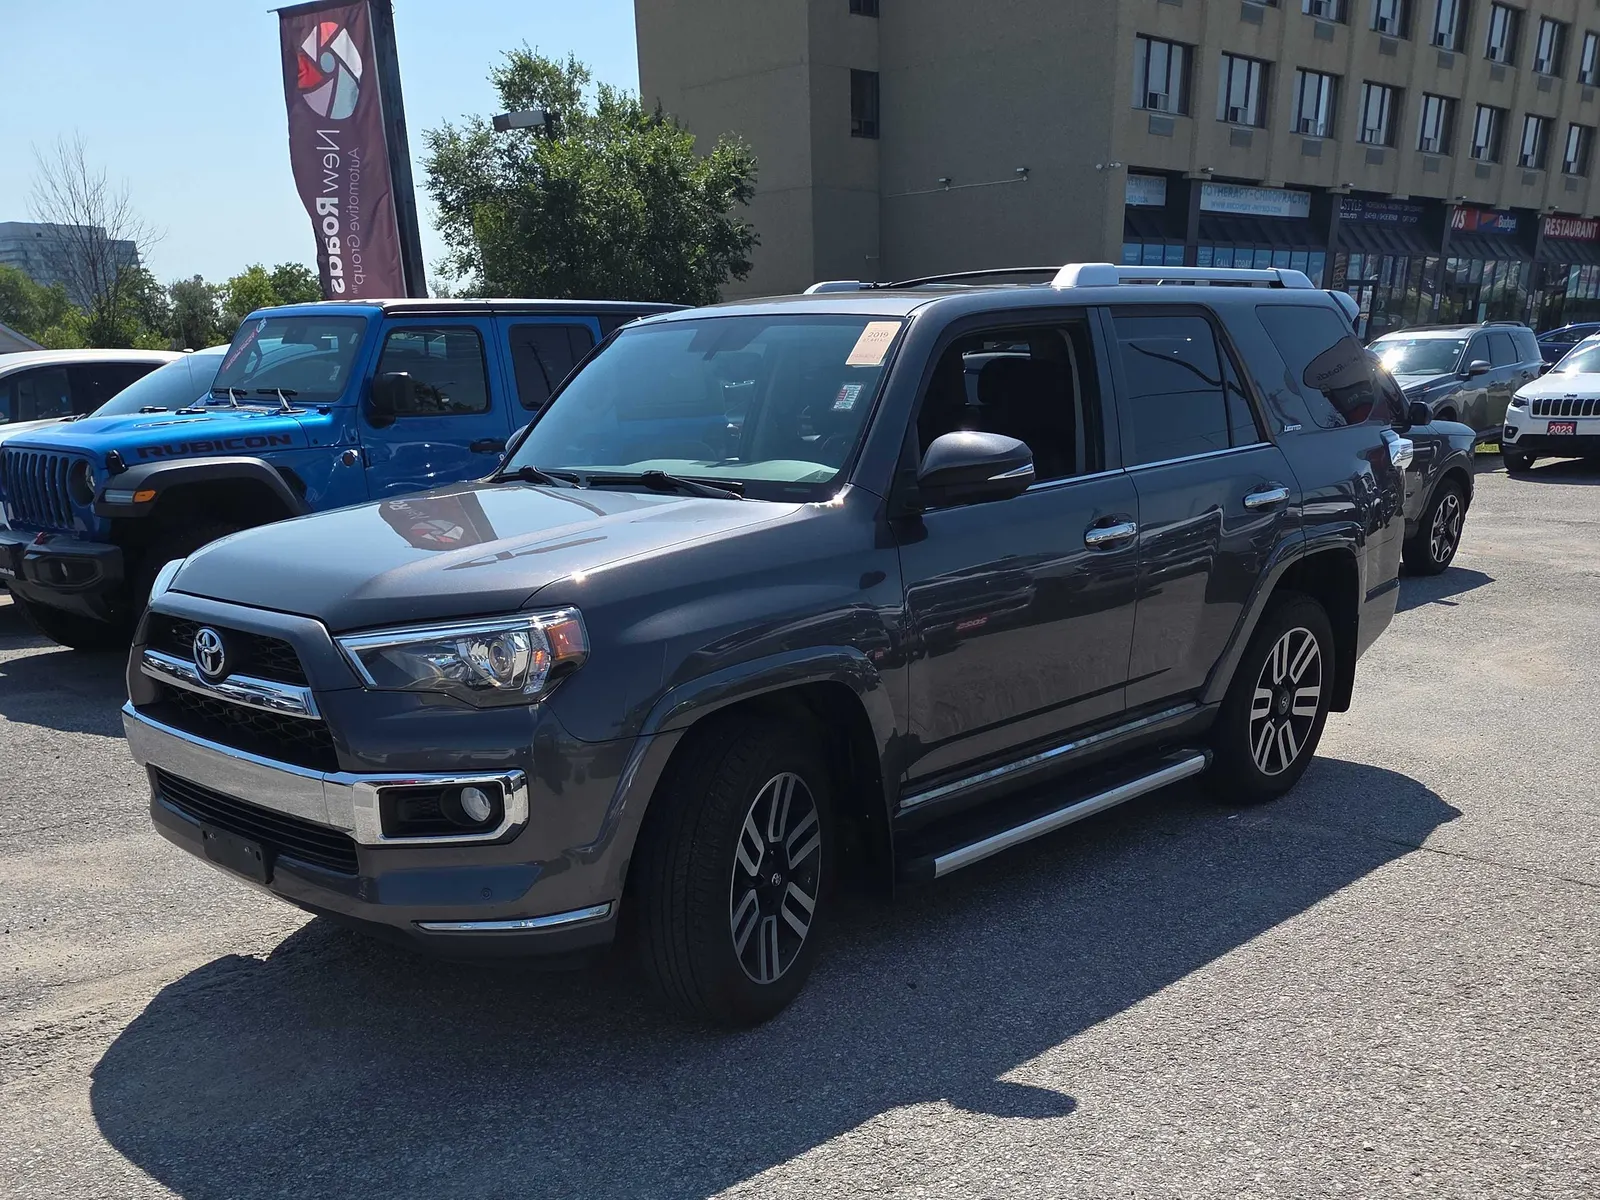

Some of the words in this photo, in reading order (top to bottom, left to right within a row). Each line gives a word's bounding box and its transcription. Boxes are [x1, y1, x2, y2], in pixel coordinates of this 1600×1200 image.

[1498, 214, 1517, 231] Budget
[1543, 218, 1599, 238] RESTAURANT
[1549, 425, 1573, 435] 2023
[136, 434, 292, 459] RUBICON
